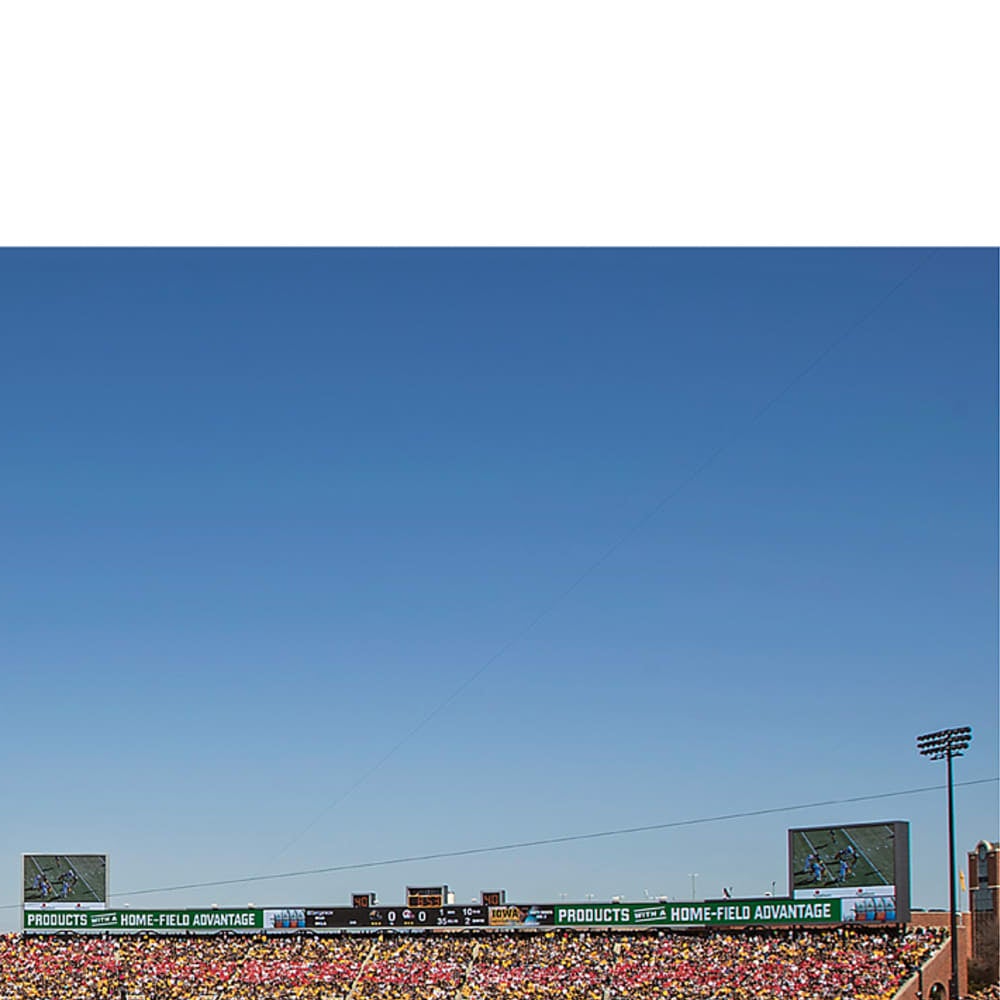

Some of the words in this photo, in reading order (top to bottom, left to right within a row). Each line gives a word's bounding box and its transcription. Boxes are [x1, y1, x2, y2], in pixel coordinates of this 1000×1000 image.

[387, 911, 396, 922] 0
[418, 911, 426, 921] 0
[558, 908, 630, 922] PRODUCTS
[634, 911, 657, 919] WITH
[659, 909, 666, 917] A
[671, 905, 750, 921] HOME-FIELD
[754, 903, 831, 920] ADVANTAGE
[27, 913, 87, 926] PRODUCTS
[120, 913, 190, 926] HOME-FIELD
[192, 913, 255, 926] ADVANTAGE
